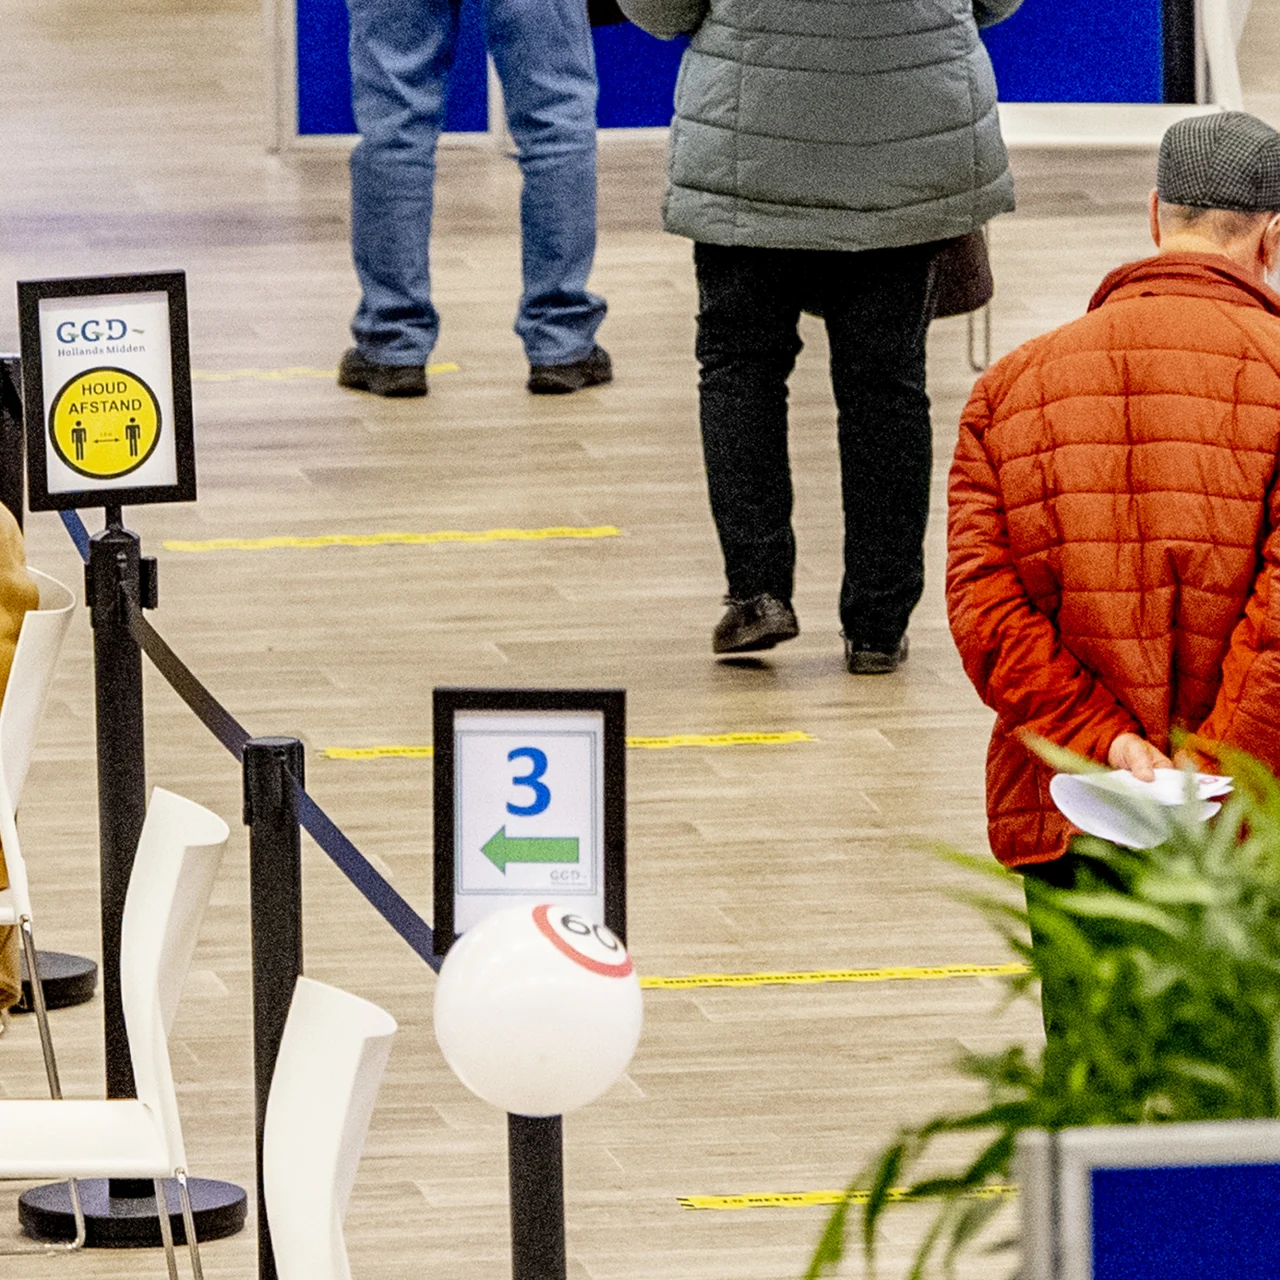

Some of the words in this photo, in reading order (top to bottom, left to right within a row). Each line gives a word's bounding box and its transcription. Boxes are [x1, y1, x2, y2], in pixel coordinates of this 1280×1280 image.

[56, 319, 128, 344] GGD
[58, 345, 104, 357] Hollands
[106, 344, 146, 354] Midden
[82, 381, 128, 396] HOUD
[69, 398, 142, 415] AFSTAND
[506, 746, 551, 817] 3
